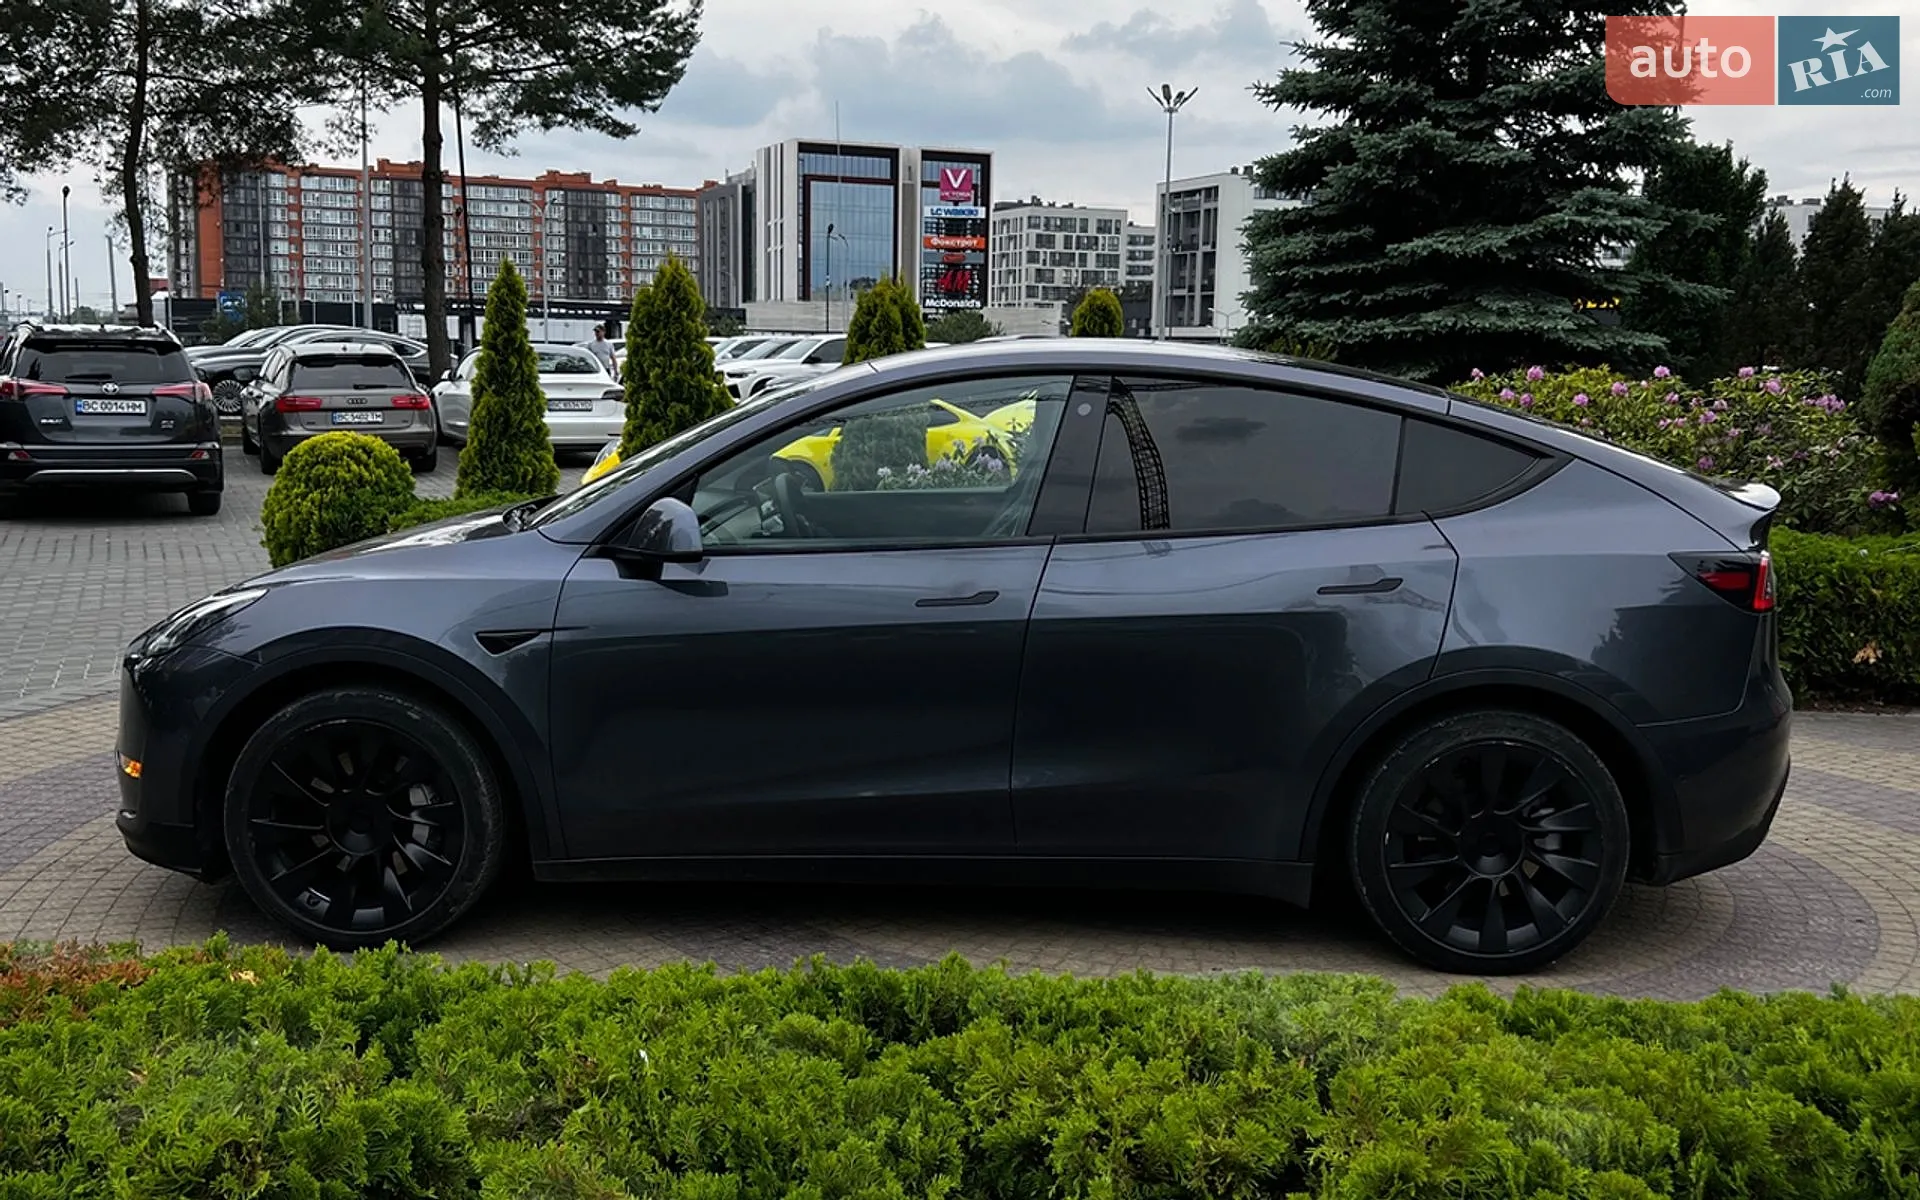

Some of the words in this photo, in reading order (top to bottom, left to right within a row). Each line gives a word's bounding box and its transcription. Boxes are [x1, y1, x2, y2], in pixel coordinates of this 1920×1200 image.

[930, 207, 942, 216] LC
[925, 298, 981, 308] McDonald's
[100, 401, 125, 411] 0014
